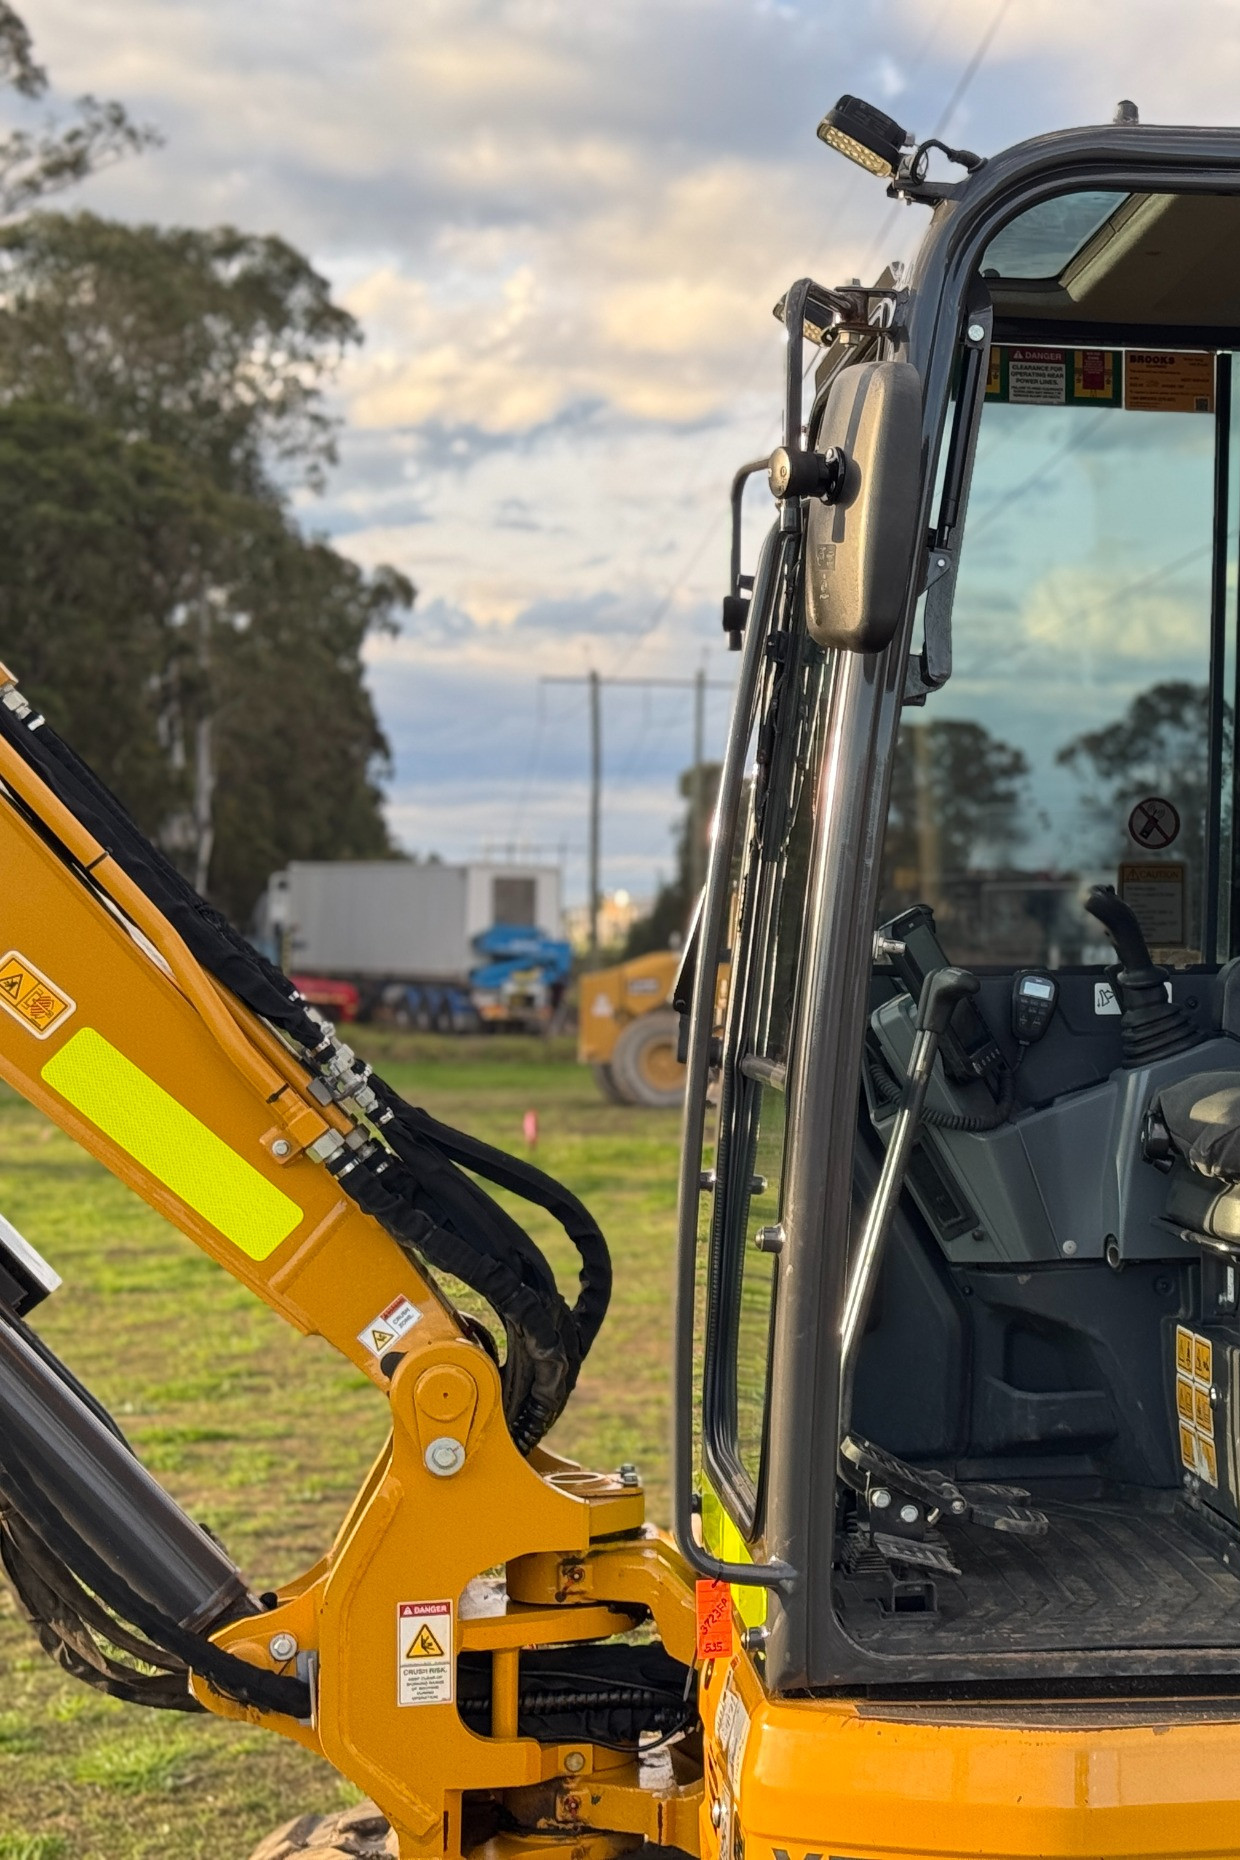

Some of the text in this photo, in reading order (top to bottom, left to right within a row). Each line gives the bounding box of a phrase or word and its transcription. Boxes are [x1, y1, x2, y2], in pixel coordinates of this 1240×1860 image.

[1025, 351, 1062, 360] DANGER
[1129, 354, 1175, 365] BROOKS
[413, 1605, 448, 1615] DANGER
[403, 1668, 428, 1676] CRUSH
